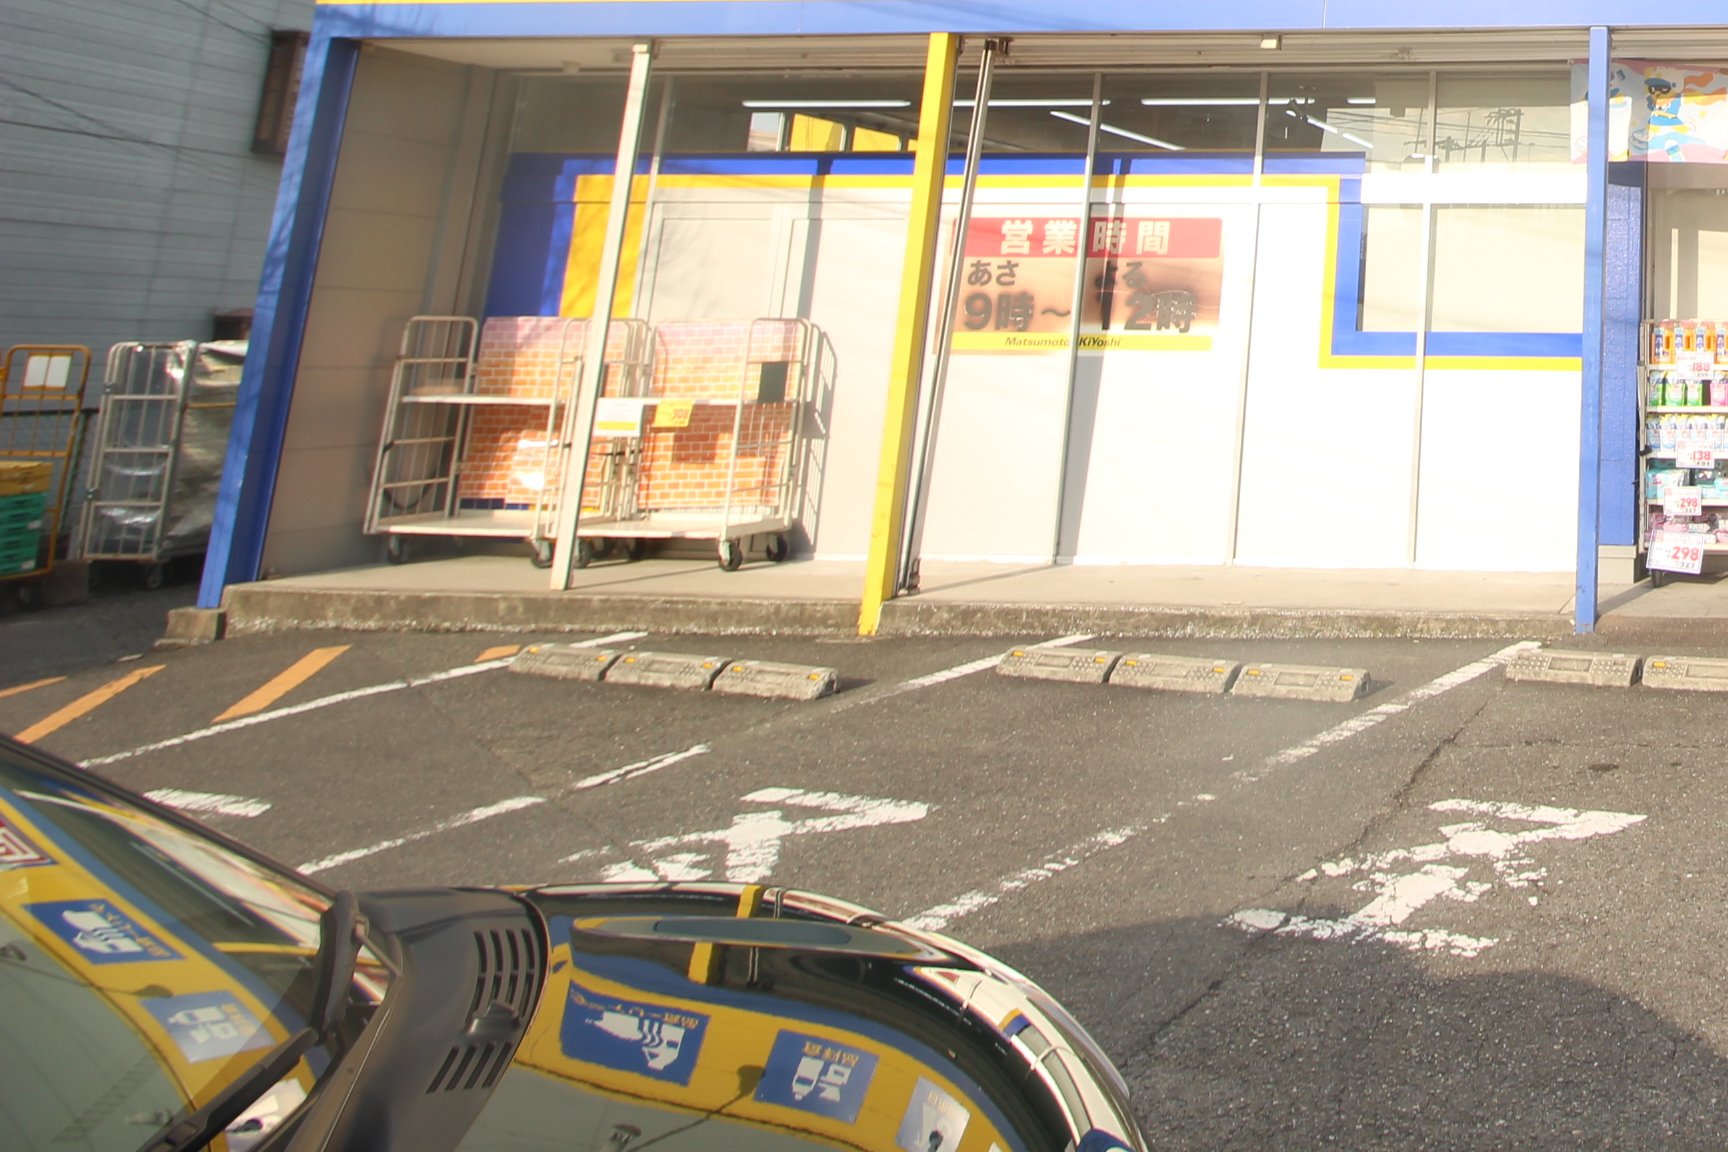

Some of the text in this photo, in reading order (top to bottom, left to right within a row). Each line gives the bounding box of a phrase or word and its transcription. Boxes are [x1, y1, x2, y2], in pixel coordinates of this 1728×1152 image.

[1000, 220, 1171, 256] 営業時間
[967, 260, 1020, 287] あさ
[1680, 498, 1698, 508] 298
[1671, 546, 1700, 561] 298
